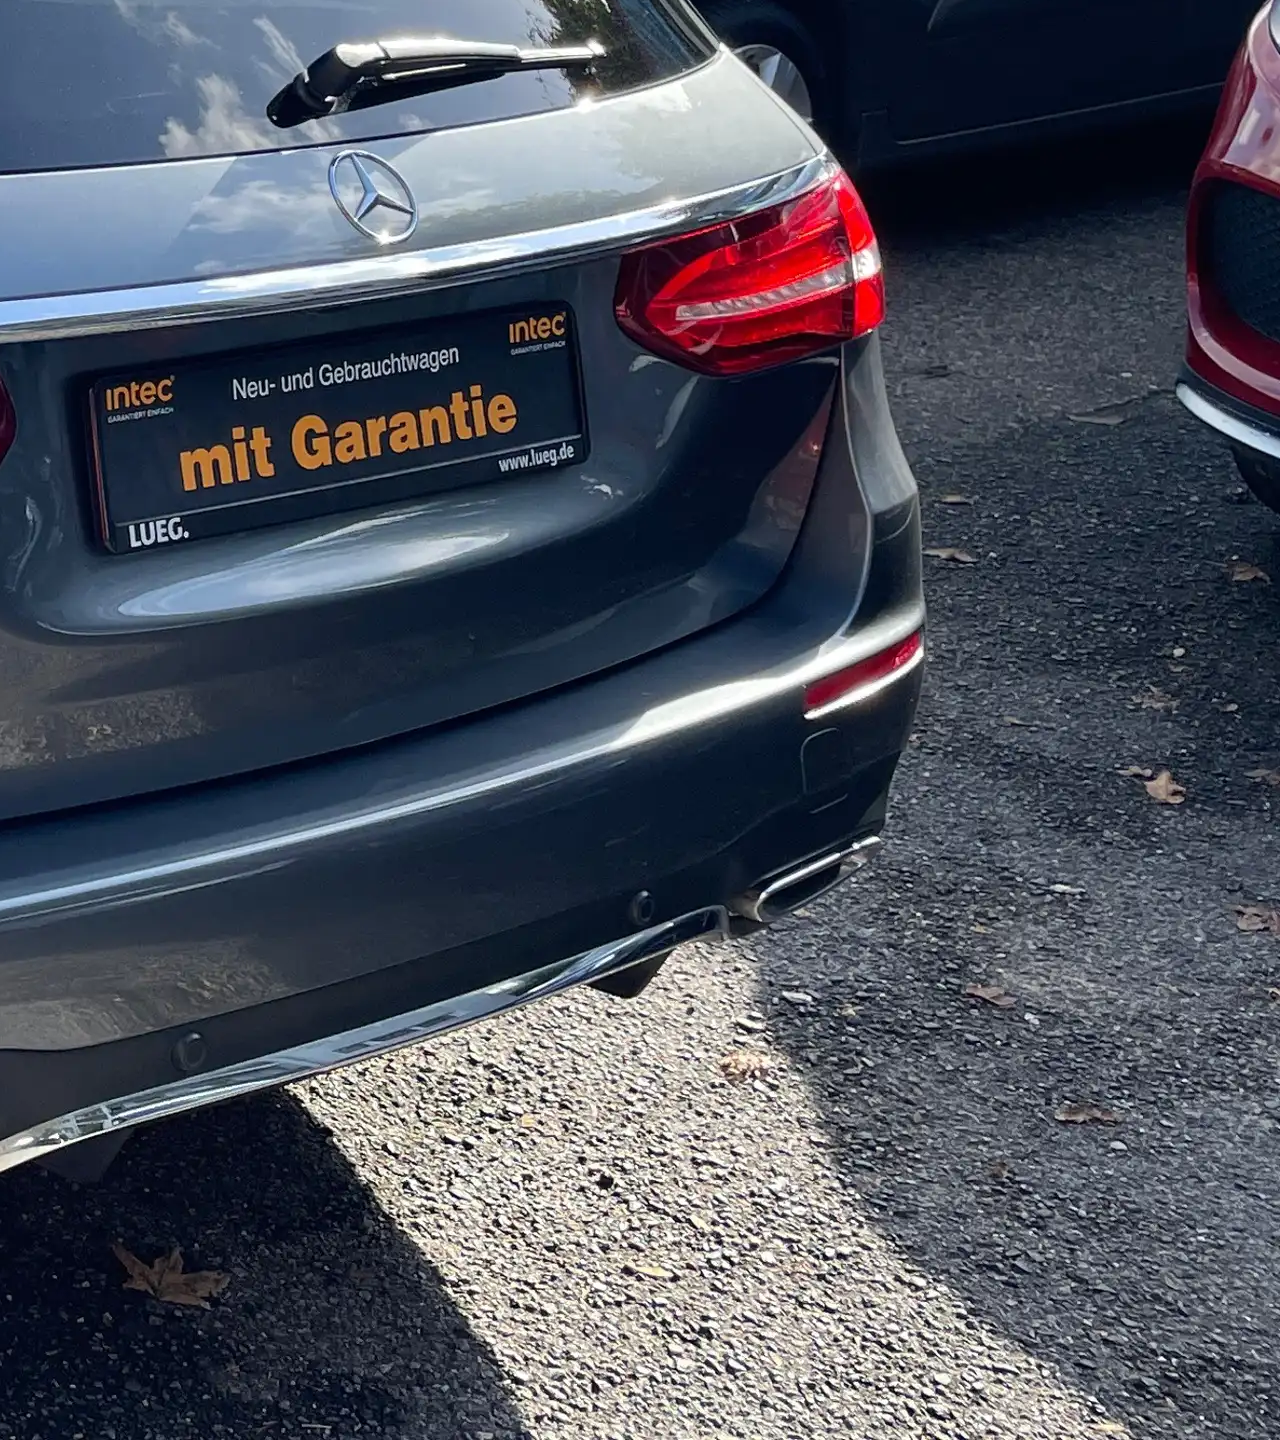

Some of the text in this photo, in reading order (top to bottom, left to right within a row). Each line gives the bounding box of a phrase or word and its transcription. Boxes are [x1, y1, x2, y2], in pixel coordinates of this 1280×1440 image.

[233, 347, 460, 401] Neu- und Gebrauchtwagen
[179, 384, 517, 492] mit Garantie
[498, 442, 575, 473] www.lueg.de
[129, 517, 190, 548] LUEG.
